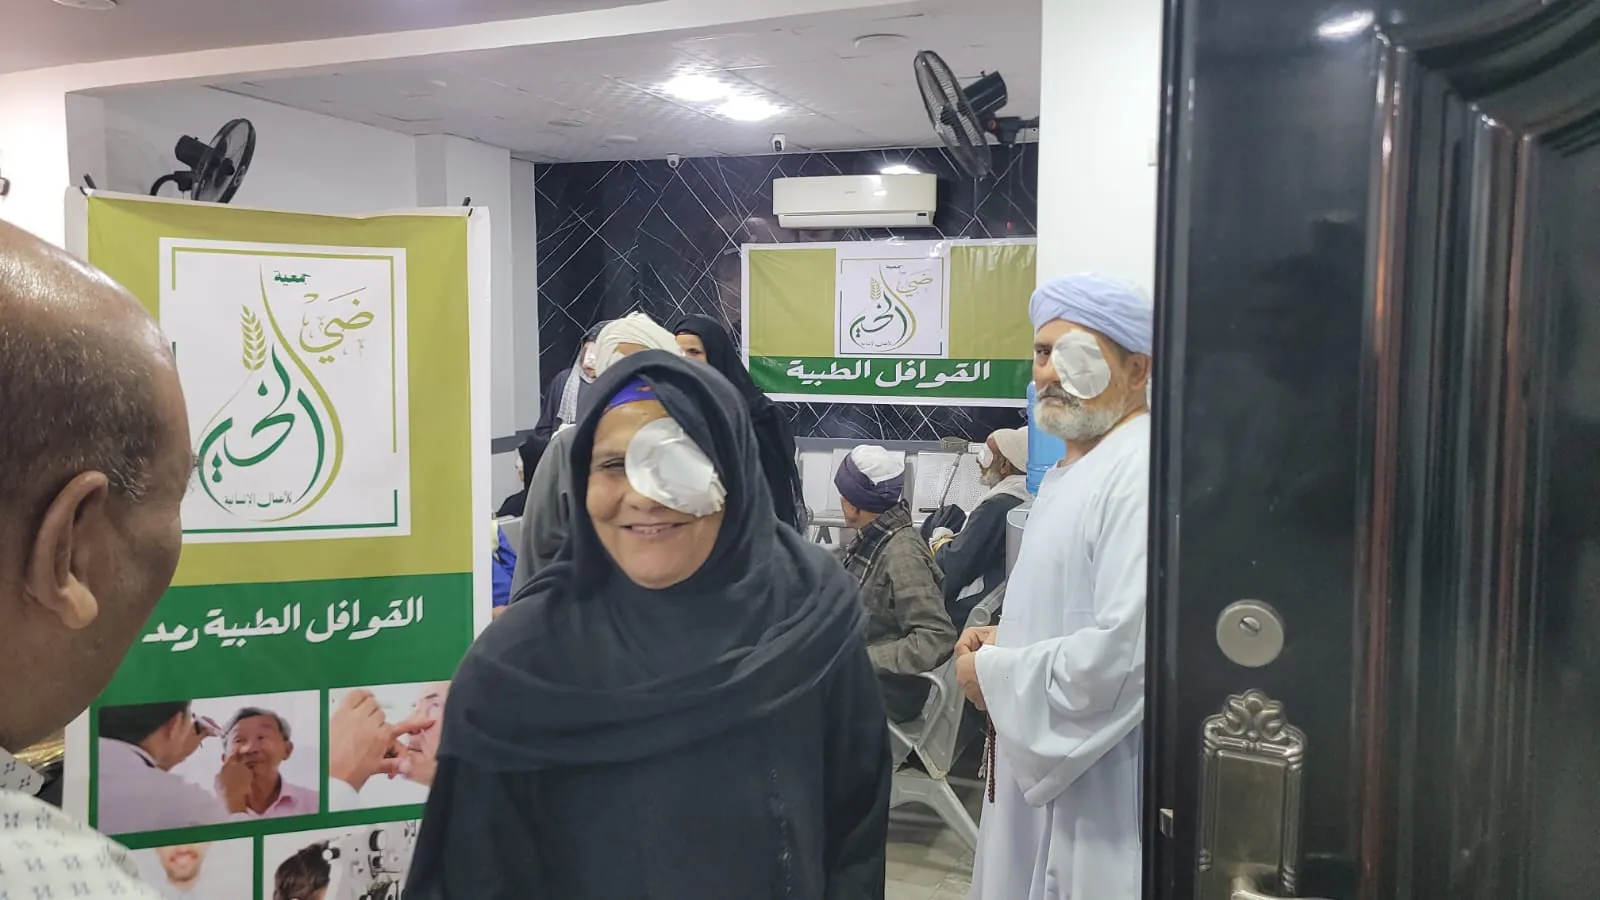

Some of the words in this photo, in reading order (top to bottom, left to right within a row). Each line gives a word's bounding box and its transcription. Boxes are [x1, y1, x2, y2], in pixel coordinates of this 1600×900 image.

[273, 270, 312, 286] جمعية
[786, 359, 871, 387] الطبية
[874, 359, 991, 389] القوافل
[203, 602, 301, 647] الطبية
[305, 595, 424, 643] القوافل
[141, 621, 199, 652] رمد
